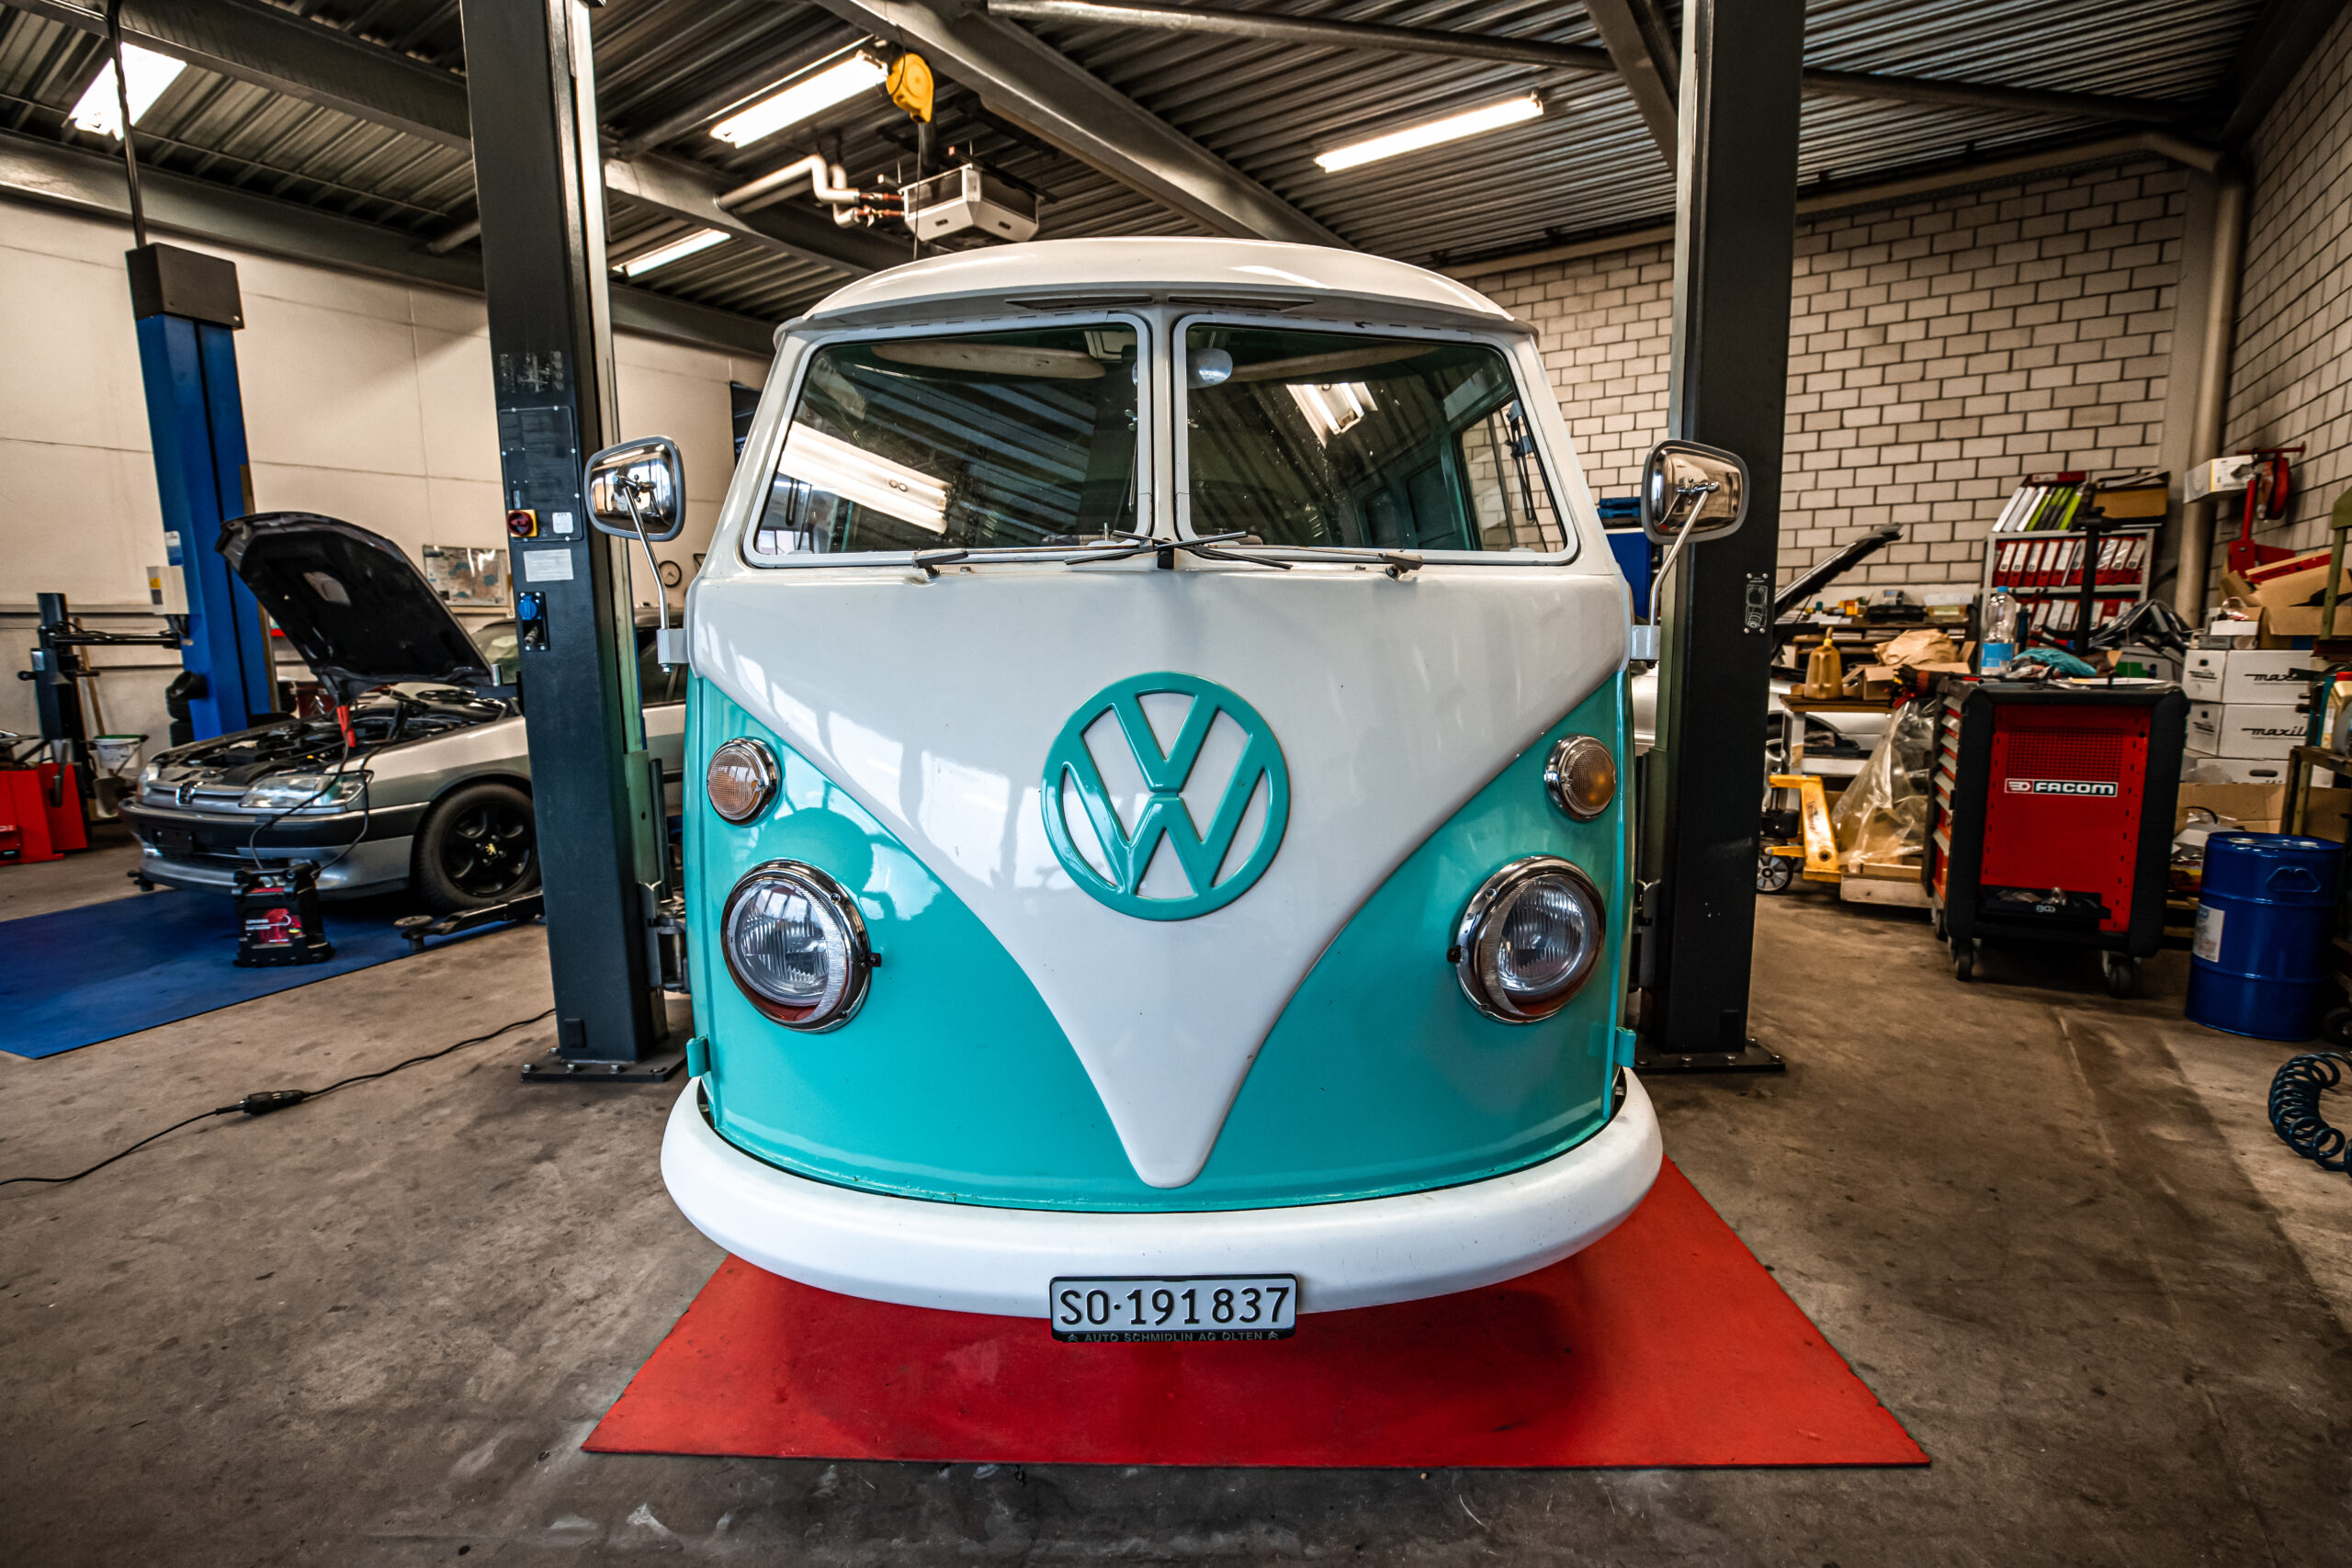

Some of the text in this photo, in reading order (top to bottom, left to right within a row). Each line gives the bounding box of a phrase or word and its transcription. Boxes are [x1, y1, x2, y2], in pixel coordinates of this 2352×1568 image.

[2035, 782, 2115, 795] FACOM
[1041, 671, 1290, 921] VW
[1084, 1331, 1263, 1342] AUTO SCHMIDLIN AG OLTEN
